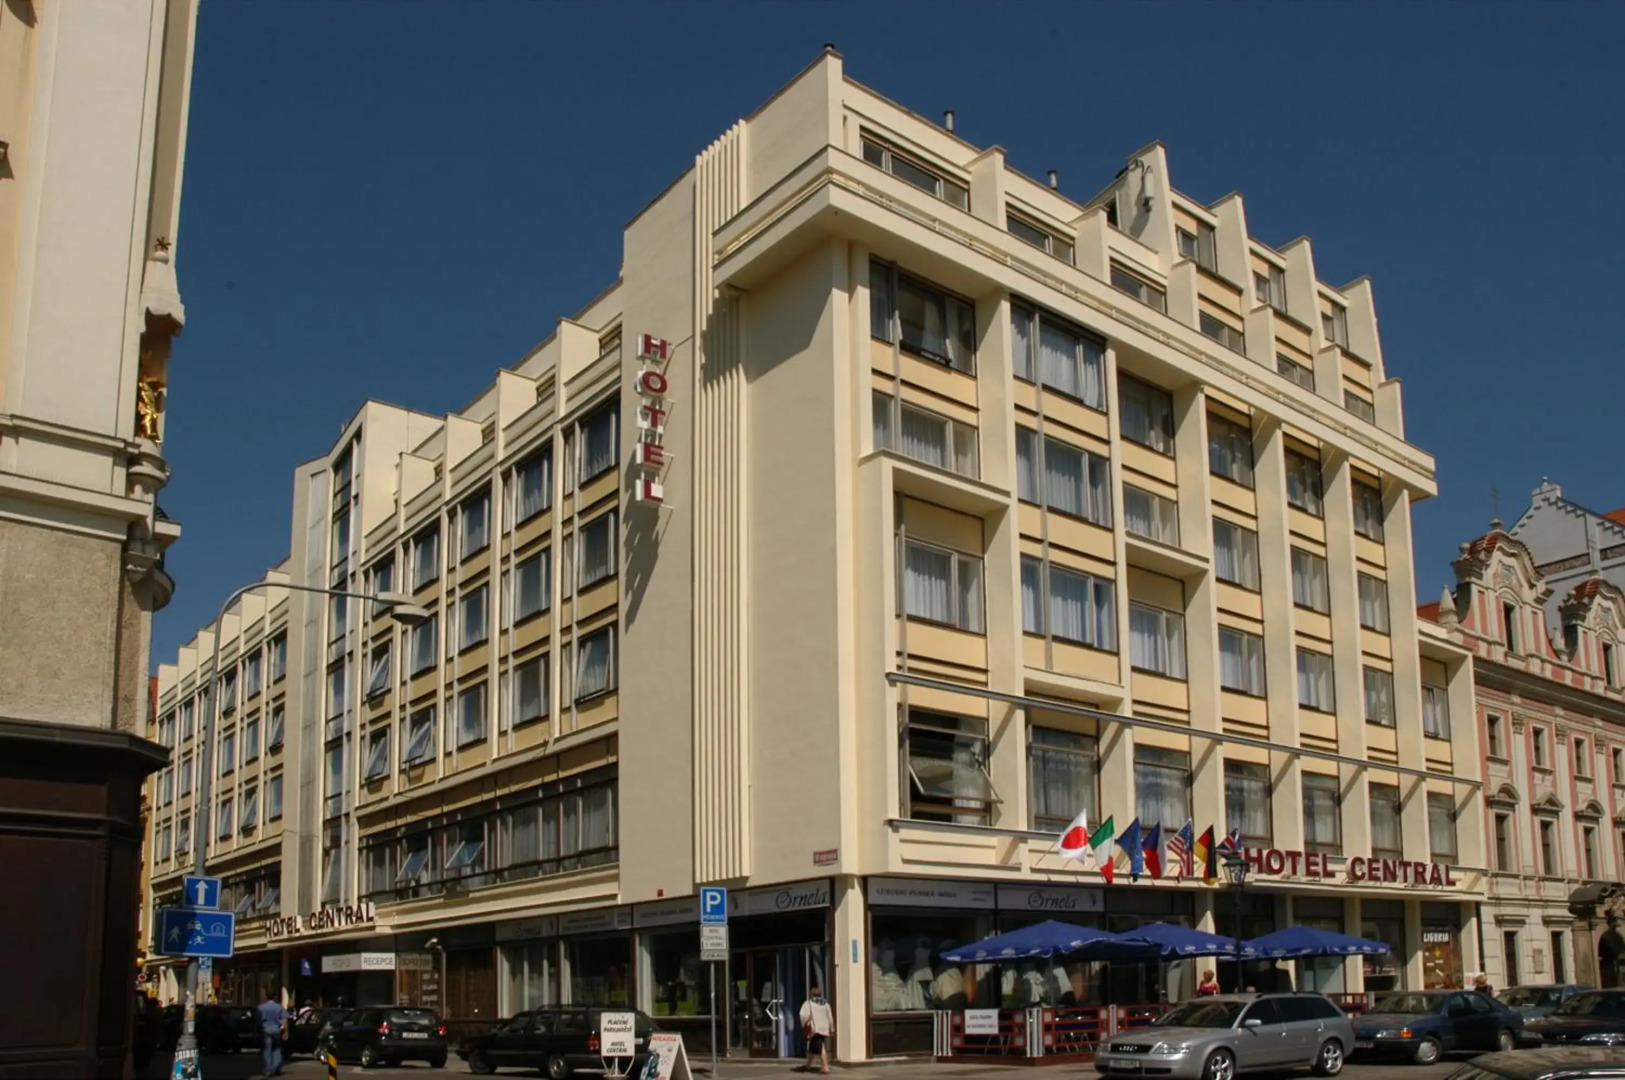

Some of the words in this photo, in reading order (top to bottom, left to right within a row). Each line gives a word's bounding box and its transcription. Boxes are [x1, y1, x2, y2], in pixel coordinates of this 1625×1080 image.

[639, 333, 668, 504] HOTEL
[1243, 847, 1336, 879] HOTEL
[1350, 856, 1457, 887] CENTRAL
[706, 891, 721, 913] P
[776, 888, 830, 910] Ornela
[1027, 891, 1078, 909] Ornela
[264, 914, 301, 938] HOTEL
[309, 901, 375, 931] CENTRAL
